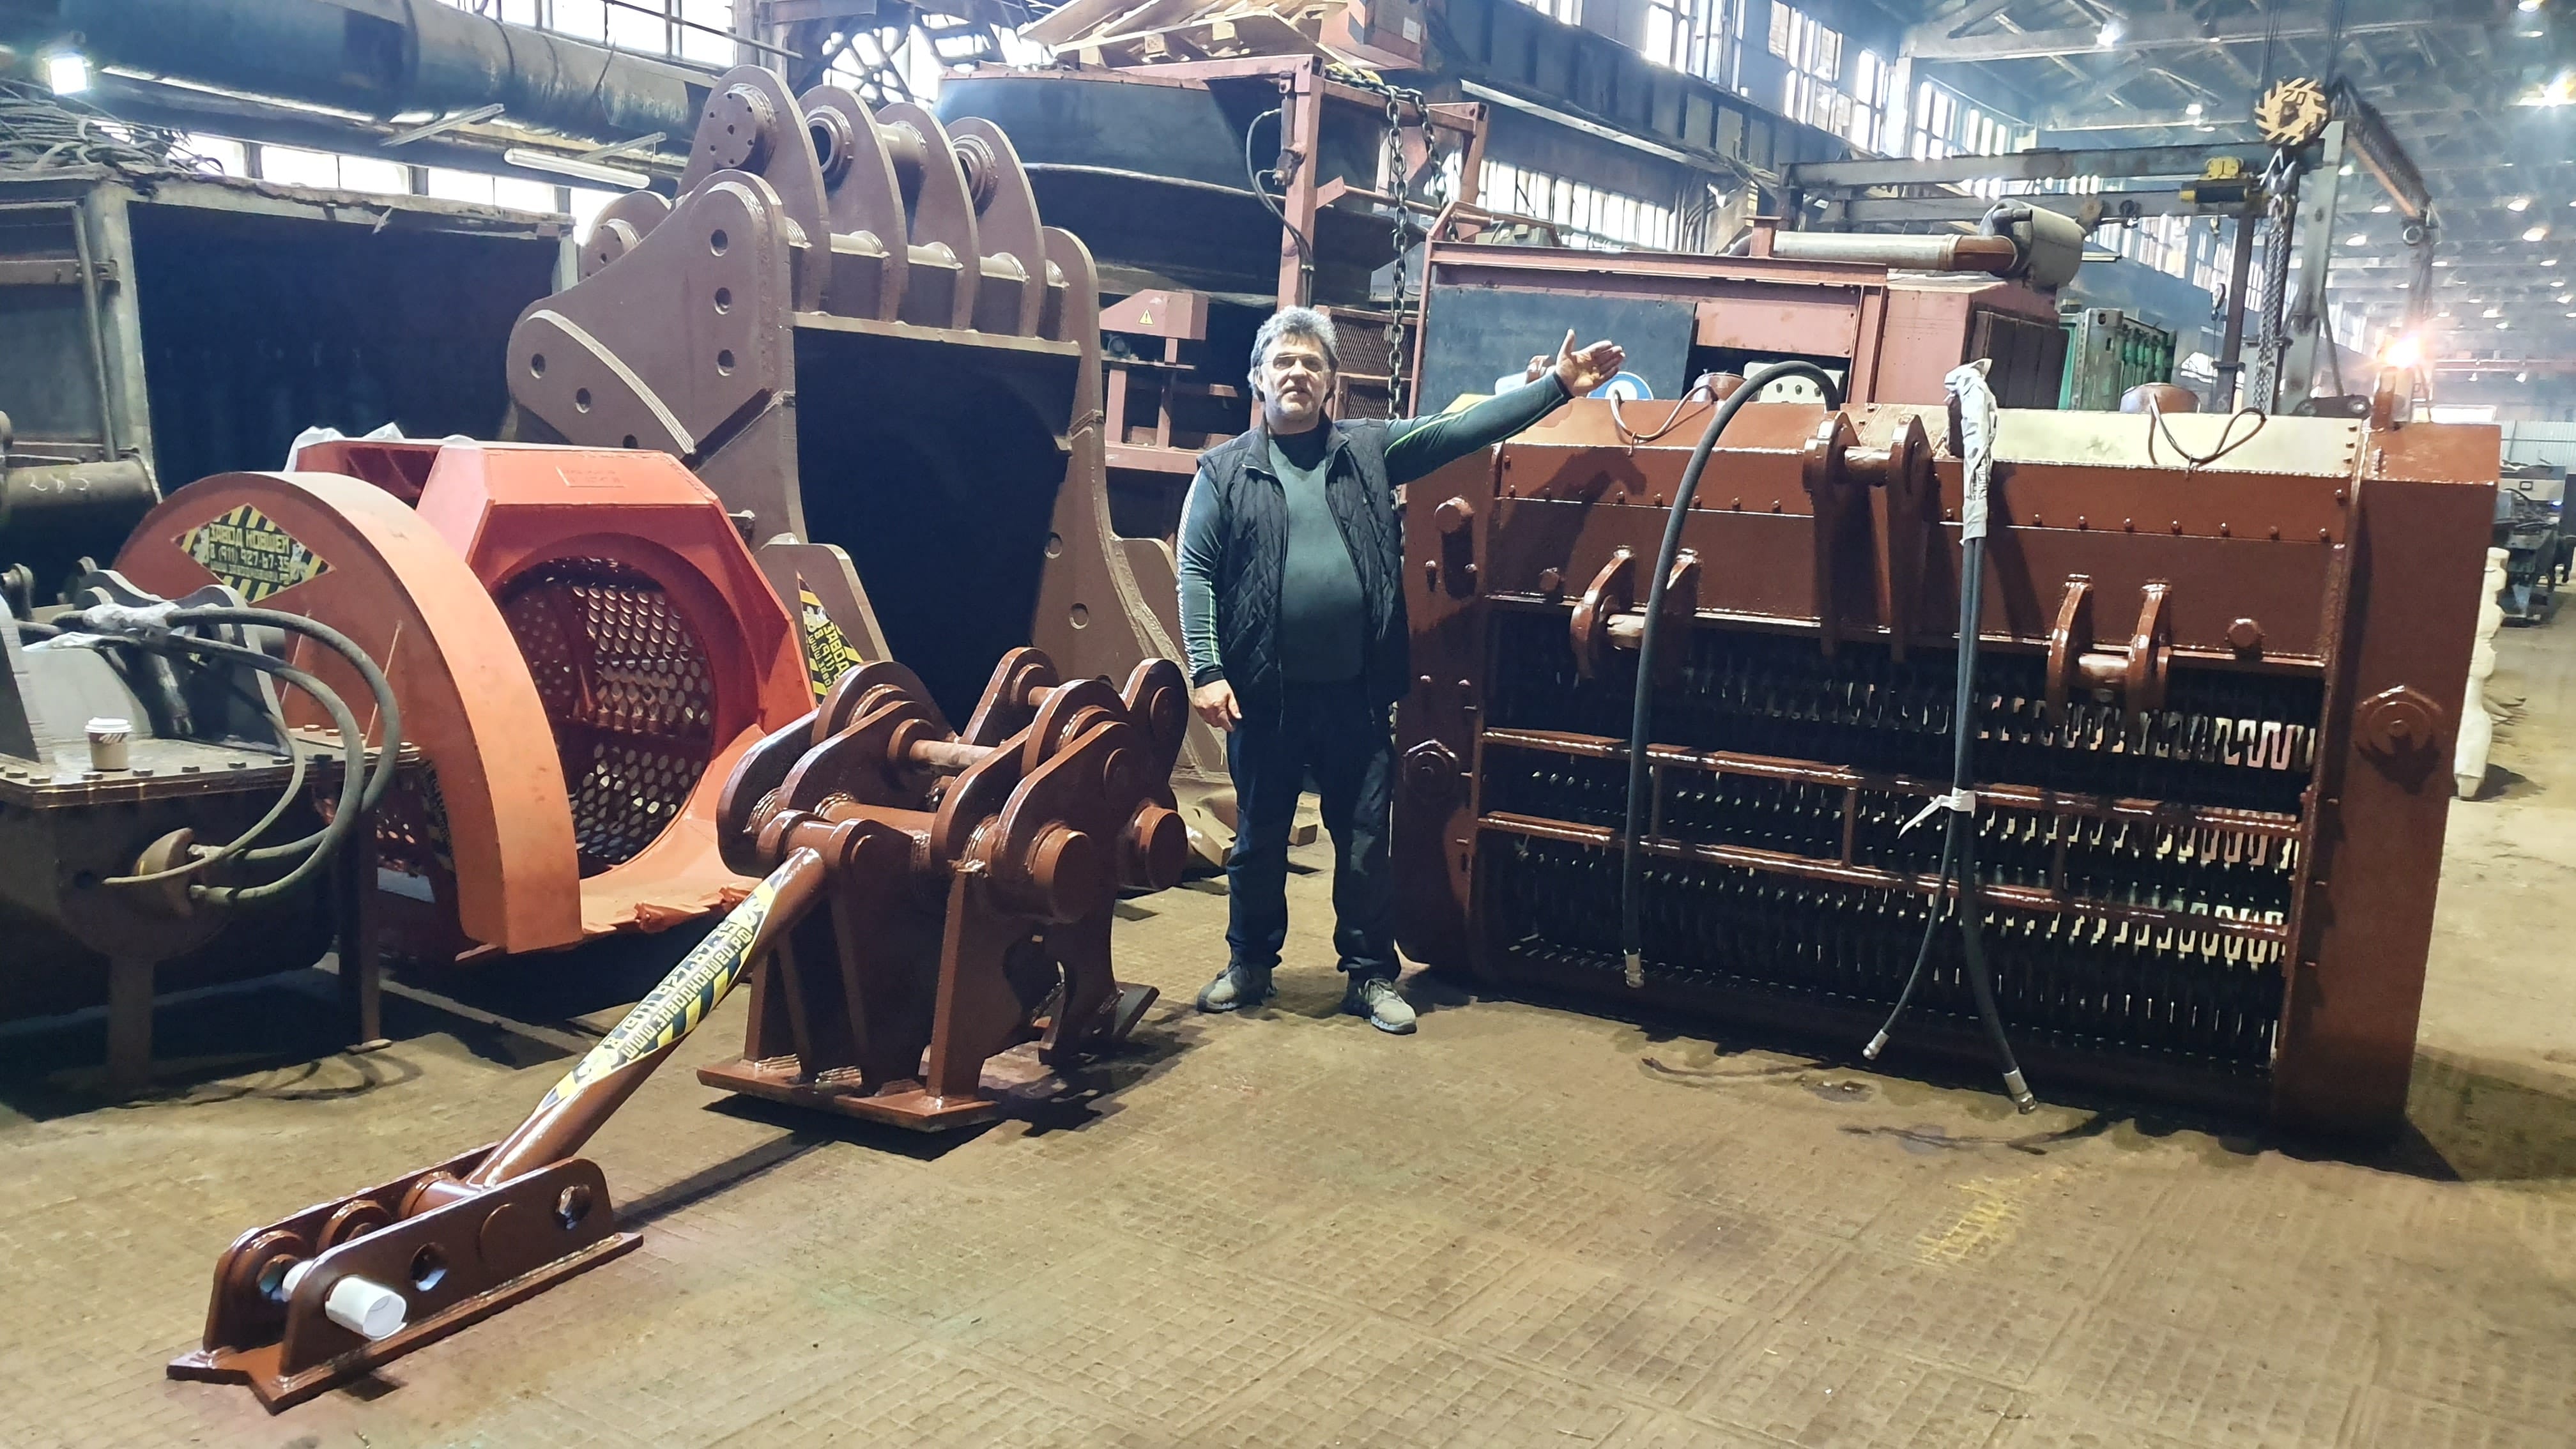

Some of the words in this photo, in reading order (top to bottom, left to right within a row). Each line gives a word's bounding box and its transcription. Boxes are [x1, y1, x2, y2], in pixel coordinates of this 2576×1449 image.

[2281, 89, 2307, 105] 20
[209, 523, 243, 548] ЗАВОД
[814, 629, 824, 640] 8
[818, 643, 835, 671] (911)
[823, 622, 850, 677] ЗАВОД
